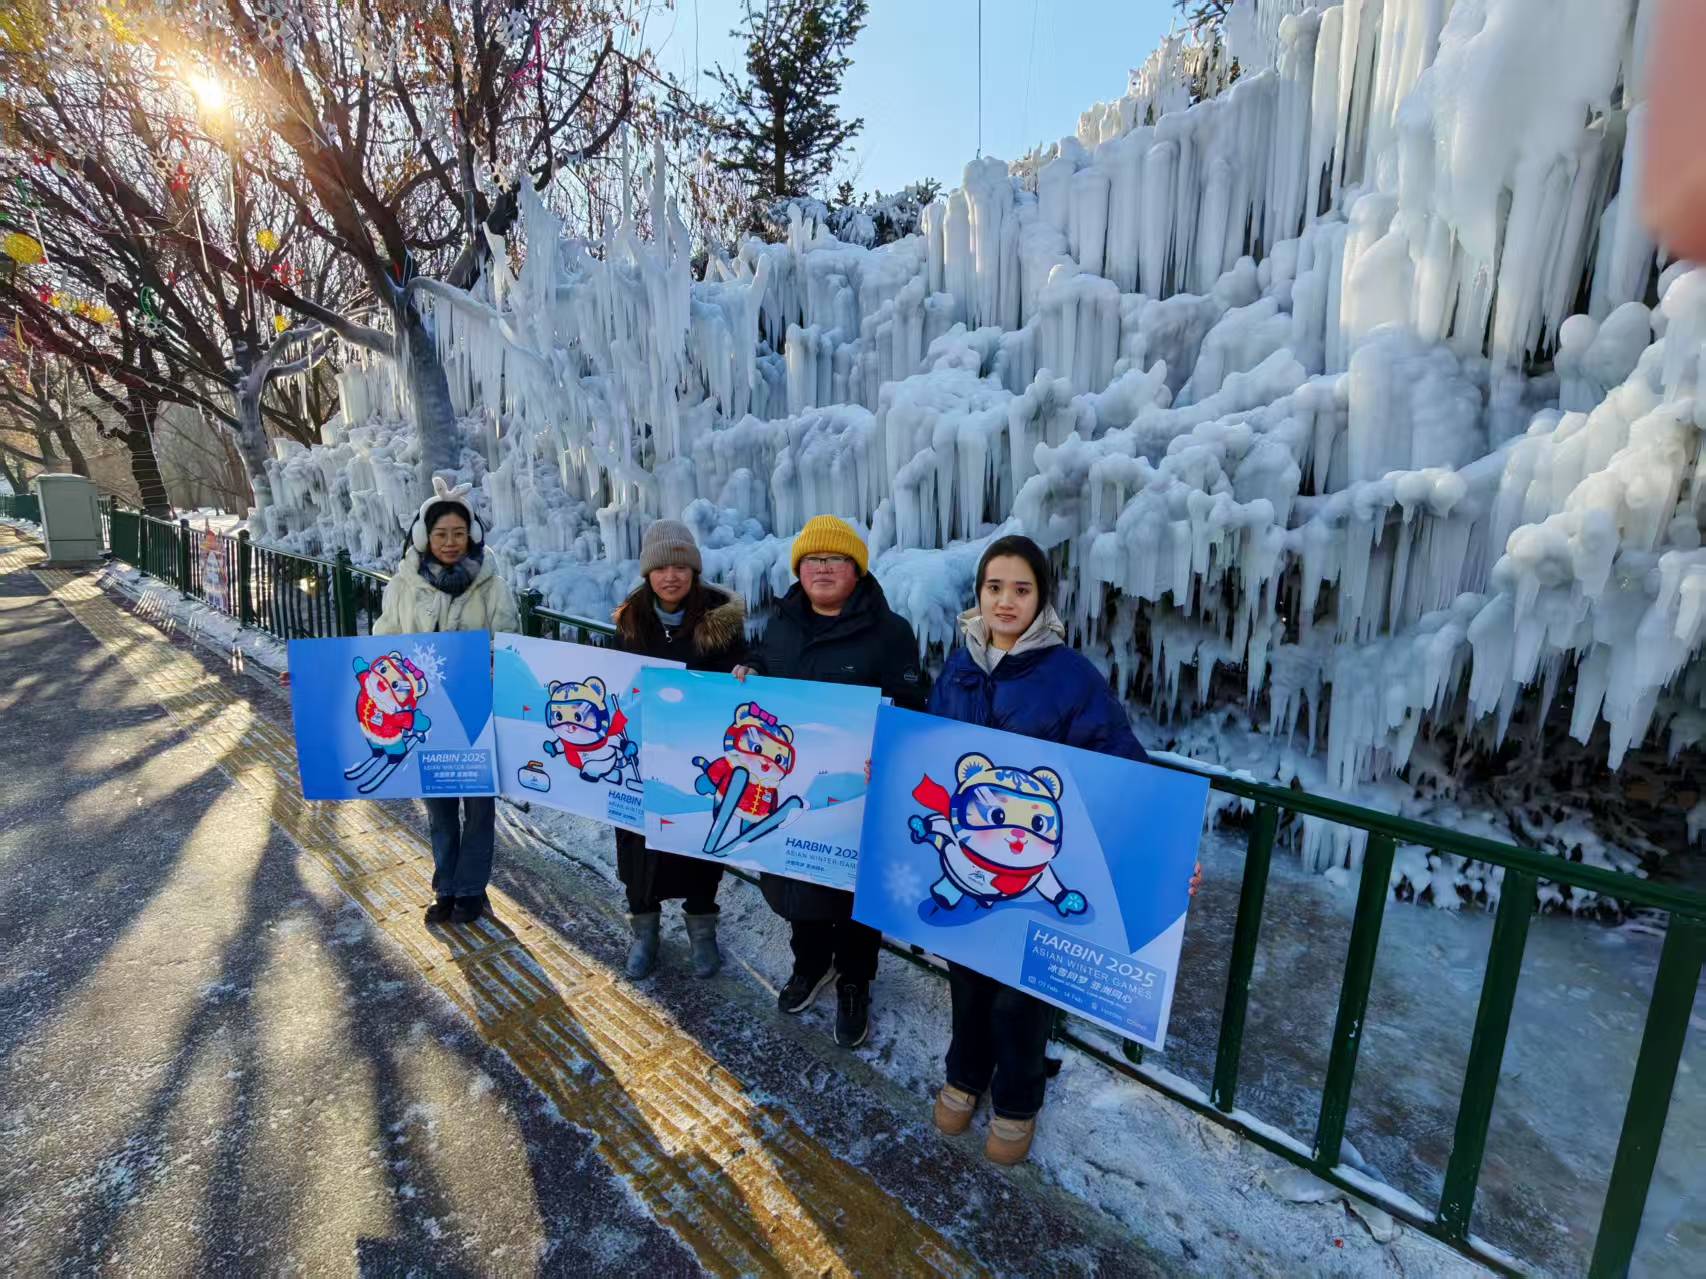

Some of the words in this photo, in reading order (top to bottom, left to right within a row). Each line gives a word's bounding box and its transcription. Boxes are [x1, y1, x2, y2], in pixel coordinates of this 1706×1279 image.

[422, 753, 460, 763] HARBIN
[461, 752, 487, 764] 2025
[608, 789, 643, 807] HARBIN
[785, 836, 832, 855] HARBIN
[834, 846, 859, 860] 202
[839, 860, 857, 870] GAM
[1033, 929, 1104, 966] HARBIN
[1106, 956, 1158, 988] 2025
[1032, 946, 1064, 964] ASIAN
[1067, 959, 1109, 982] WINTER
[1112, 976, 1153, 1001] GAMES
[1047, 963, 1089, 985] 冰雪同梦
[1089, 980, 1133, 1005] 亚洲同心
